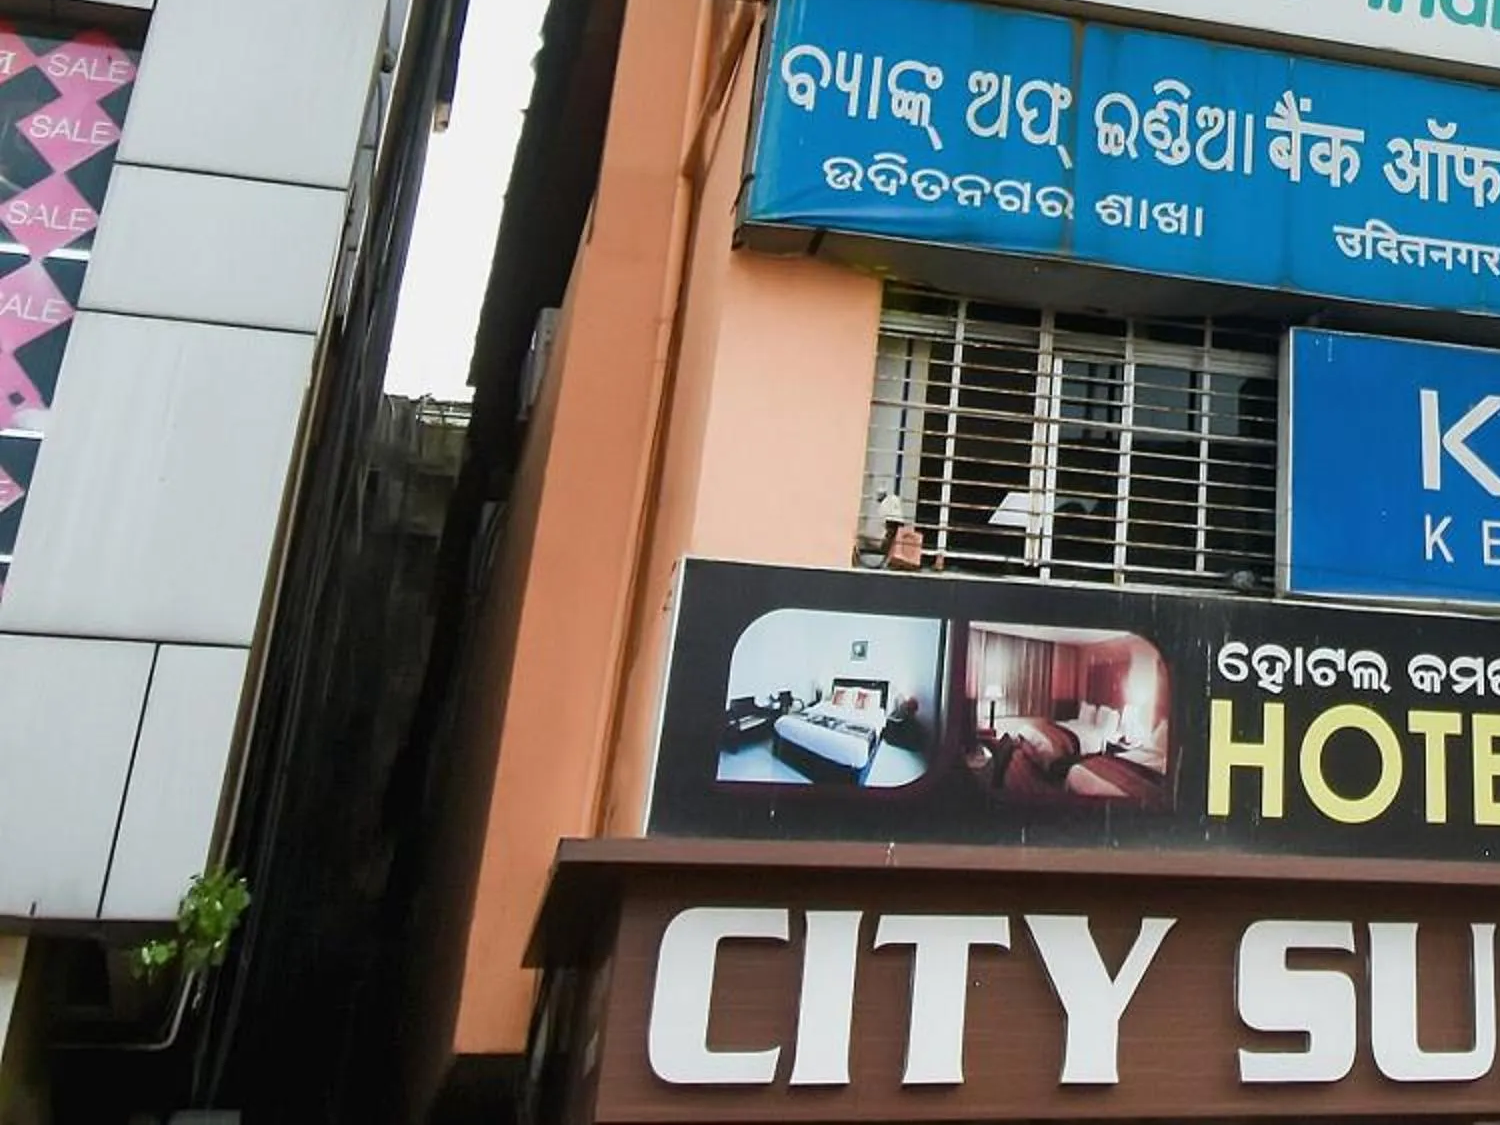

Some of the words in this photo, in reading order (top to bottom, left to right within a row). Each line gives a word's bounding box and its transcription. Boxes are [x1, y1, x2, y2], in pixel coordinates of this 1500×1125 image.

[48, 53, 130, 85] SALE
[29, 114, 115, 144] SALE
[1265, 90, 1365, 188] बैंक
[7, 200, 92, 232] SALE
[1095, 192, 1204, 237] ଶାଖା
[0, 290, 66, 325] ALE
[647, 906, 1179, 1086] CITY
